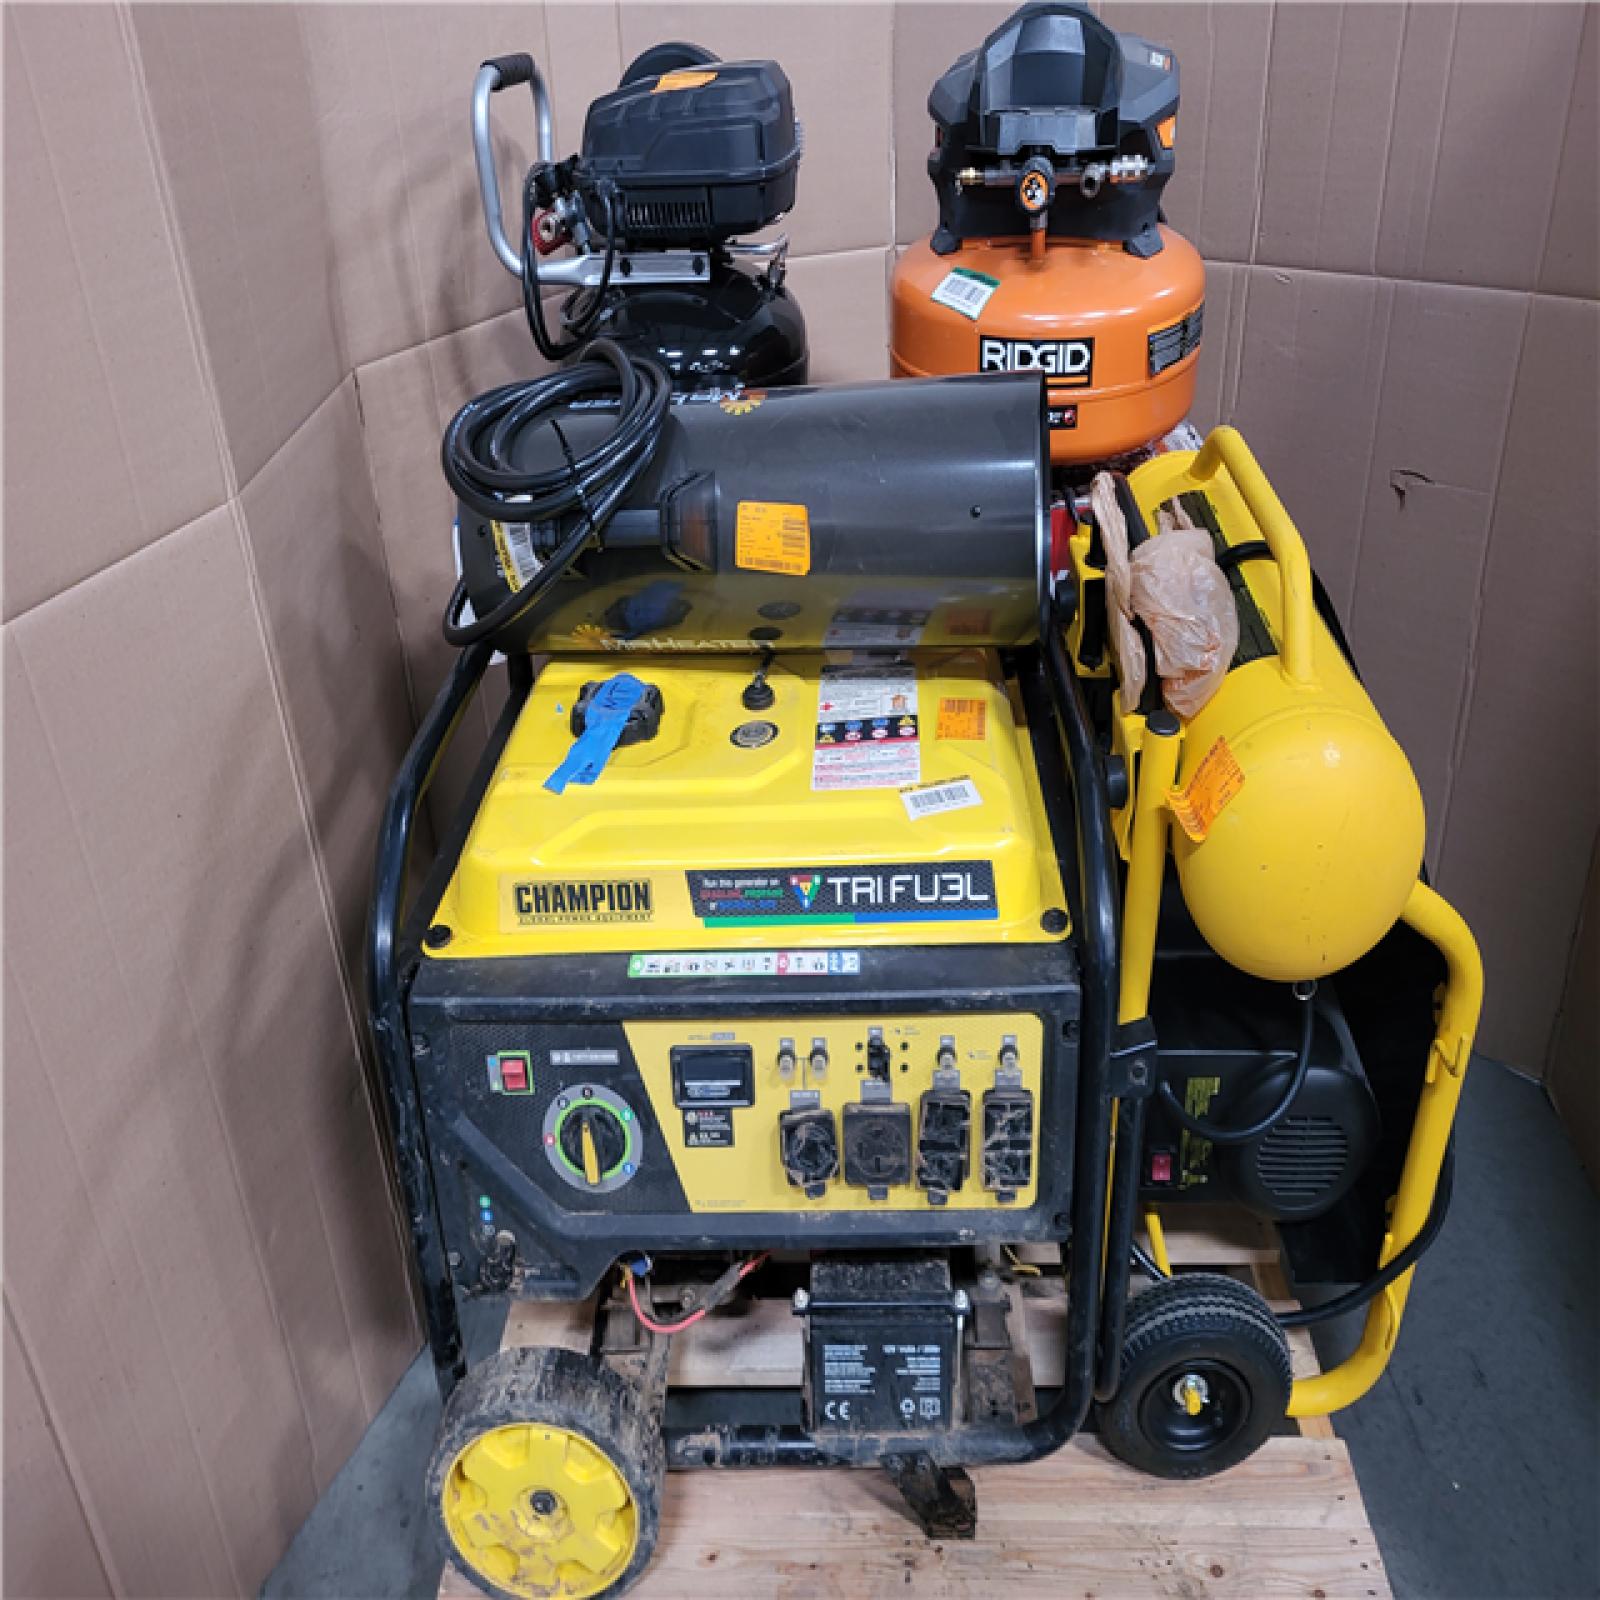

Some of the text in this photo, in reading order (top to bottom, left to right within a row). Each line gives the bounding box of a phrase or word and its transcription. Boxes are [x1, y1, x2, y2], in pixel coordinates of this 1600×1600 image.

[981, 339, 1091, 373] RIDGID
[516, 882, 651, 914] CHAMPION
[827, 874, 883, 905] TRI
[824, 1399, 851, 1421] CE
